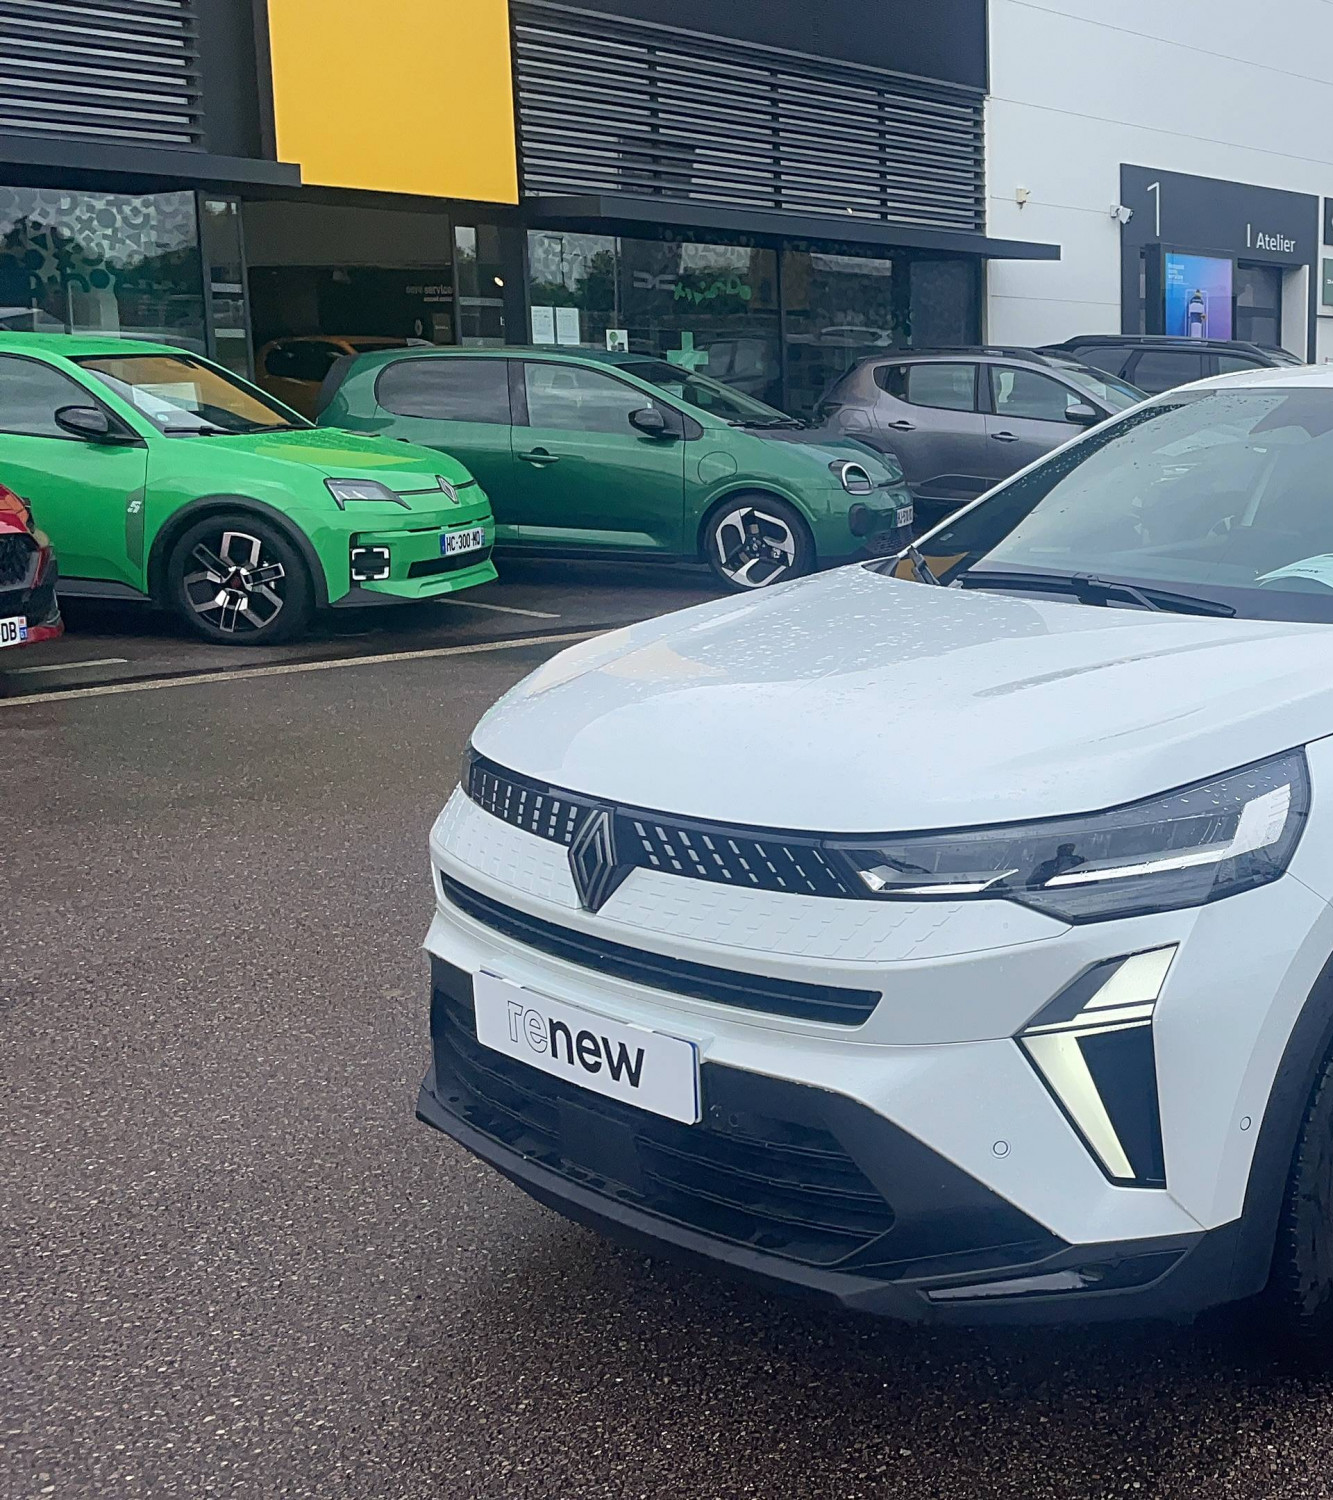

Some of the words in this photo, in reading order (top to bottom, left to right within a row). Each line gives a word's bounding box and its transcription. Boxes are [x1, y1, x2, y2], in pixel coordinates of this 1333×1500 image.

[1147, 181, 1160, 237] 1
[1256, 232, 1297, 253] Atelier
[508, 1000, 645, 1089] renew
